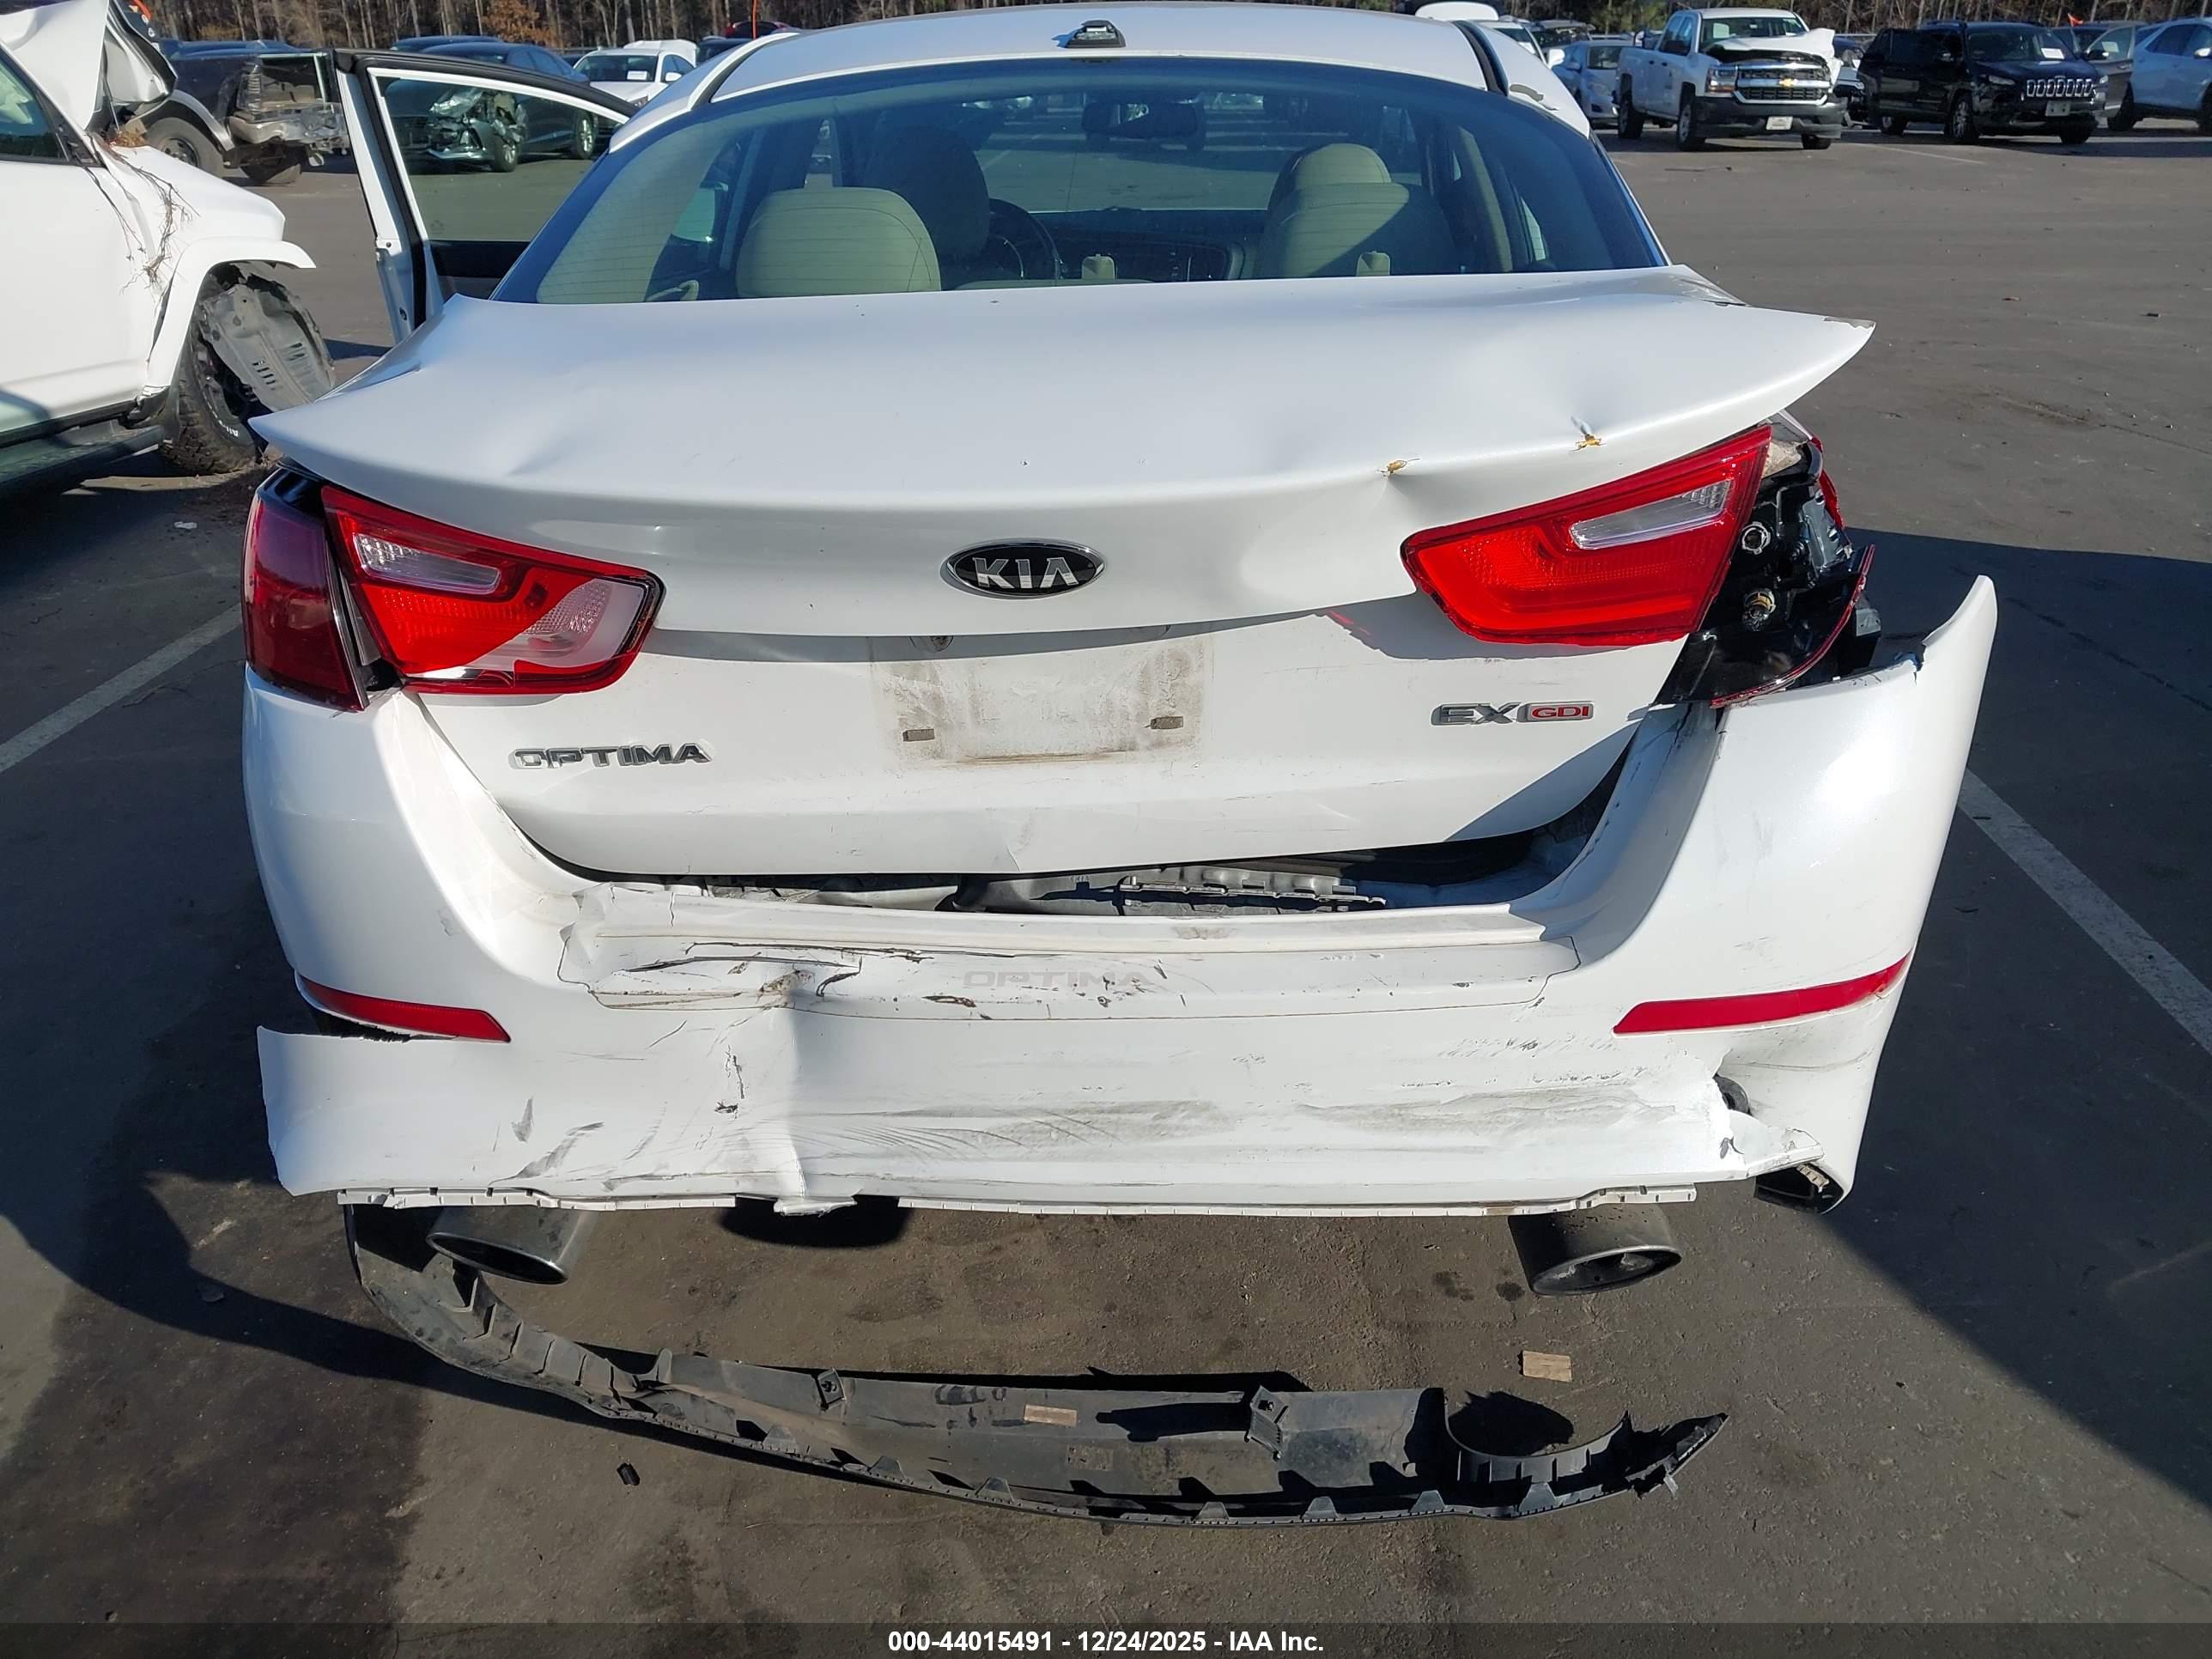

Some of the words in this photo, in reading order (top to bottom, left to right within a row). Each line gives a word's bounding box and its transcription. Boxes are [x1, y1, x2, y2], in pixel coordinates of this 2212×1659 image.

[972, 556, 1079, 589] KIA
[1431, 702, 1522, 726] EX
[1530, 705, 1589, 719] GDI
[508, 742, 714, 769] OPTIMA
[963, 970, 1153, 988] OPTIMA
